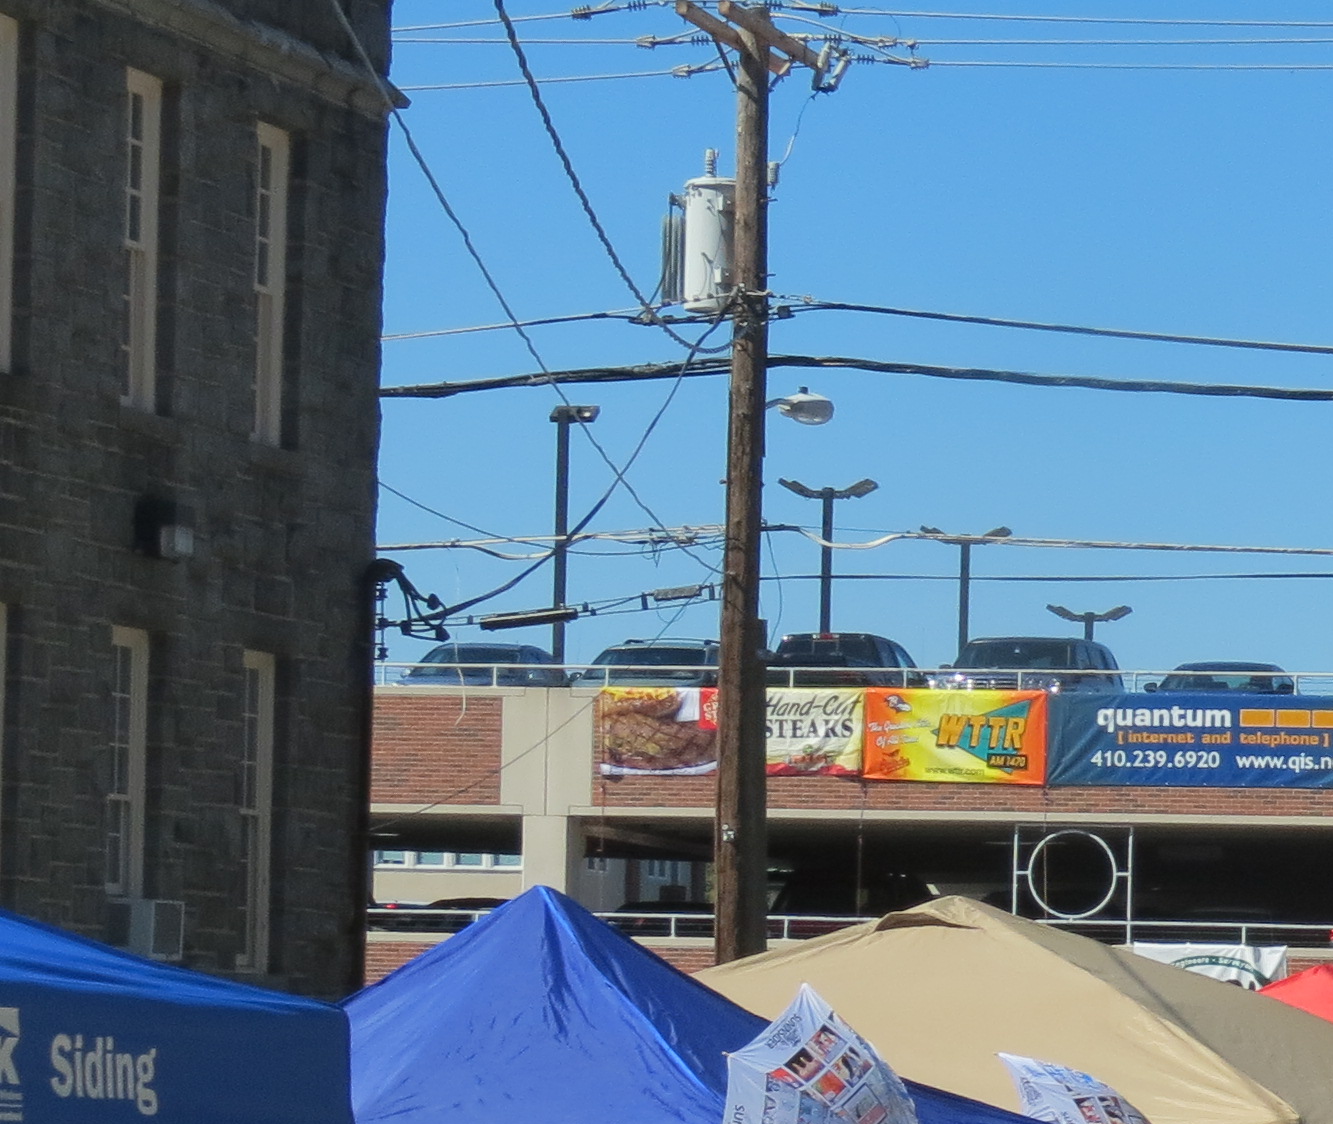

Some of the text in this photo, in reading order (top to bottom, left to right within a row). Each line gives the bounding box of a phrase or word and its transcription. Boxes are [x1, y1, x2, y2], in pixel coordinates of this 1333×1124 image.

[766, 718, 855, 739] STEAKS
[935, 713, 1028, 749] WTTR
[1097, 705, 1232, 733] quantum
[1128, 731, 1195, 744] internet
[1201, 731, 1231, 744] and
[1239, 731, 1320, 747] telephone
[1090, 750, 1221, 769] 410.239.6920
[51, 1033, 158, 1116] Siding
